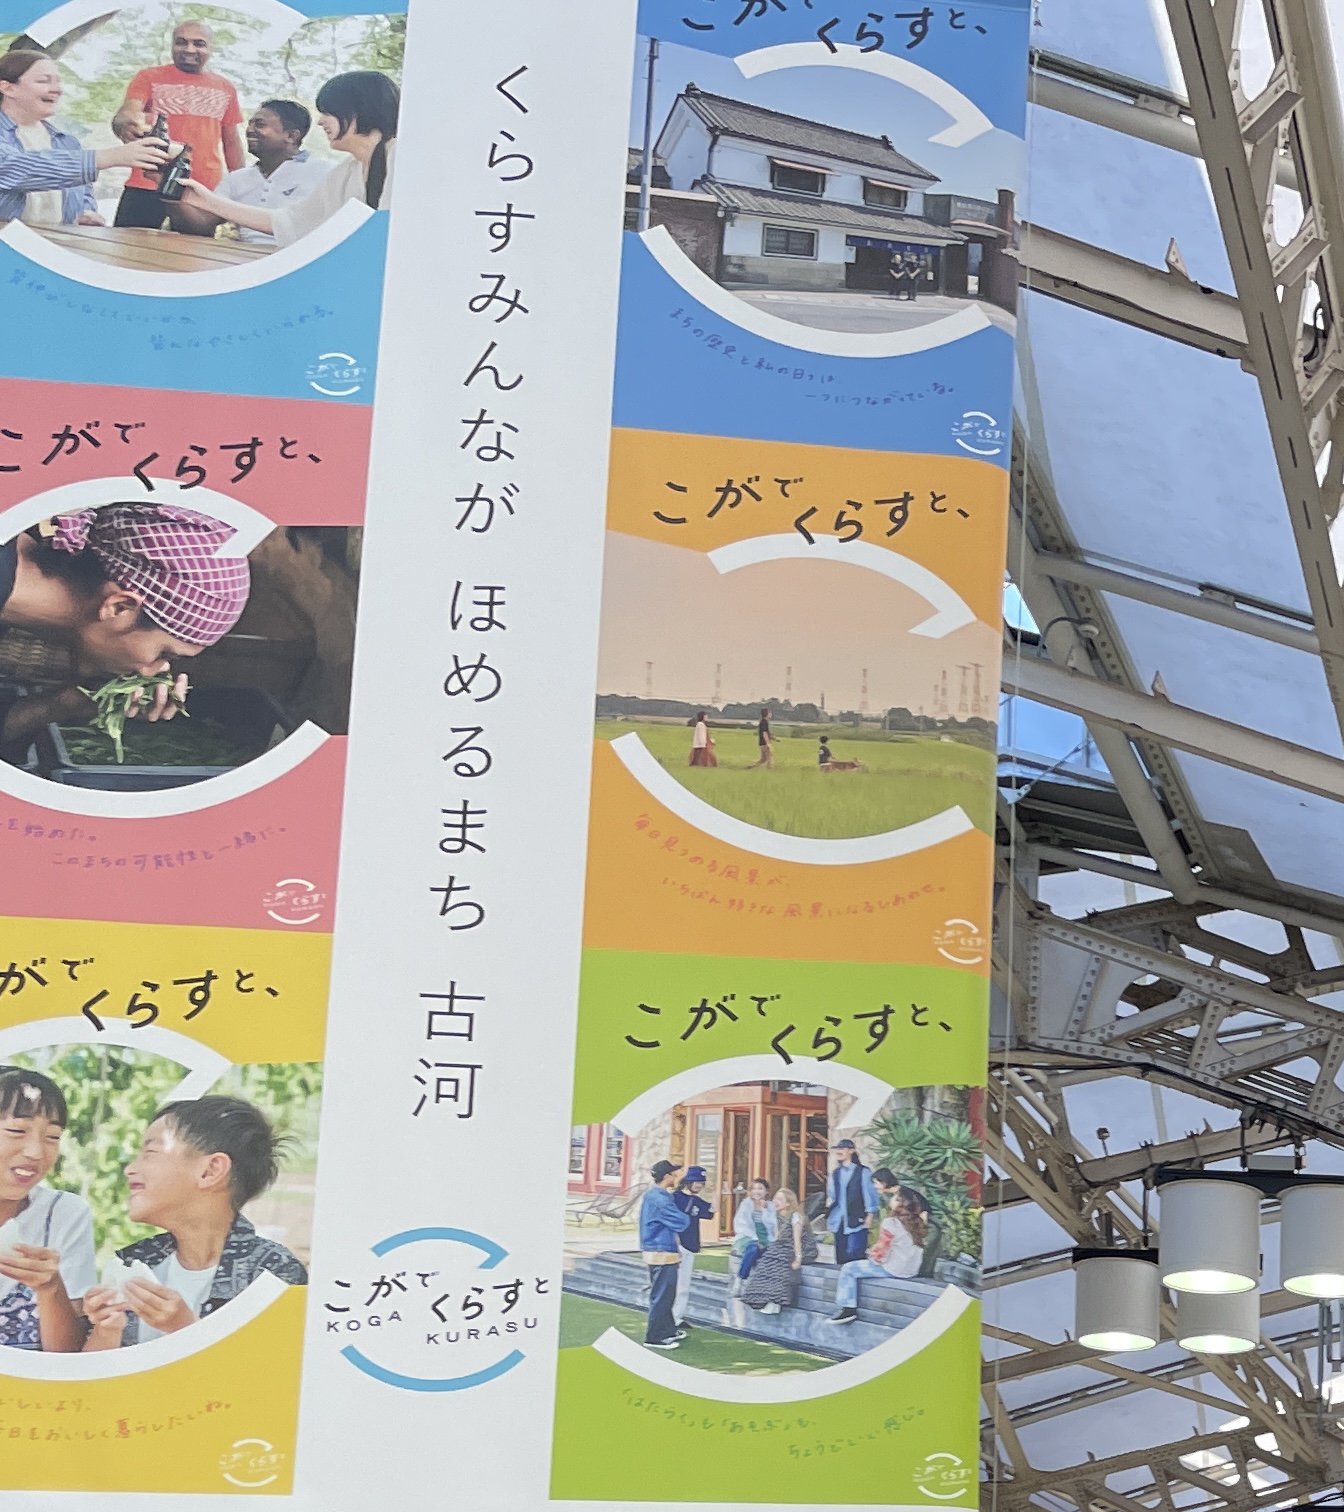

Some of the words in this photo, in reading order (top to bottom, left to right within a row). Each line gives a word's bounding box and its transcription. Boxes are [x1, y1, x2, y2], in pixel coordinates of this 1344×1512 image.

[452, 62, 538, 537] くらすみんなが
[653, 473, 971, 546] こがでくらすと、
[430, 577, 508, 932] ほめるまち
[410, 980, 487, 1120] 古河
[624, 992, 953, 1068] こがでくらすと、
[323, 1270, 550, 1324] こがでくらすと
[325, 1310, 403, 1333] KOGA
[425, 1316, 538, 1345] KURASU
